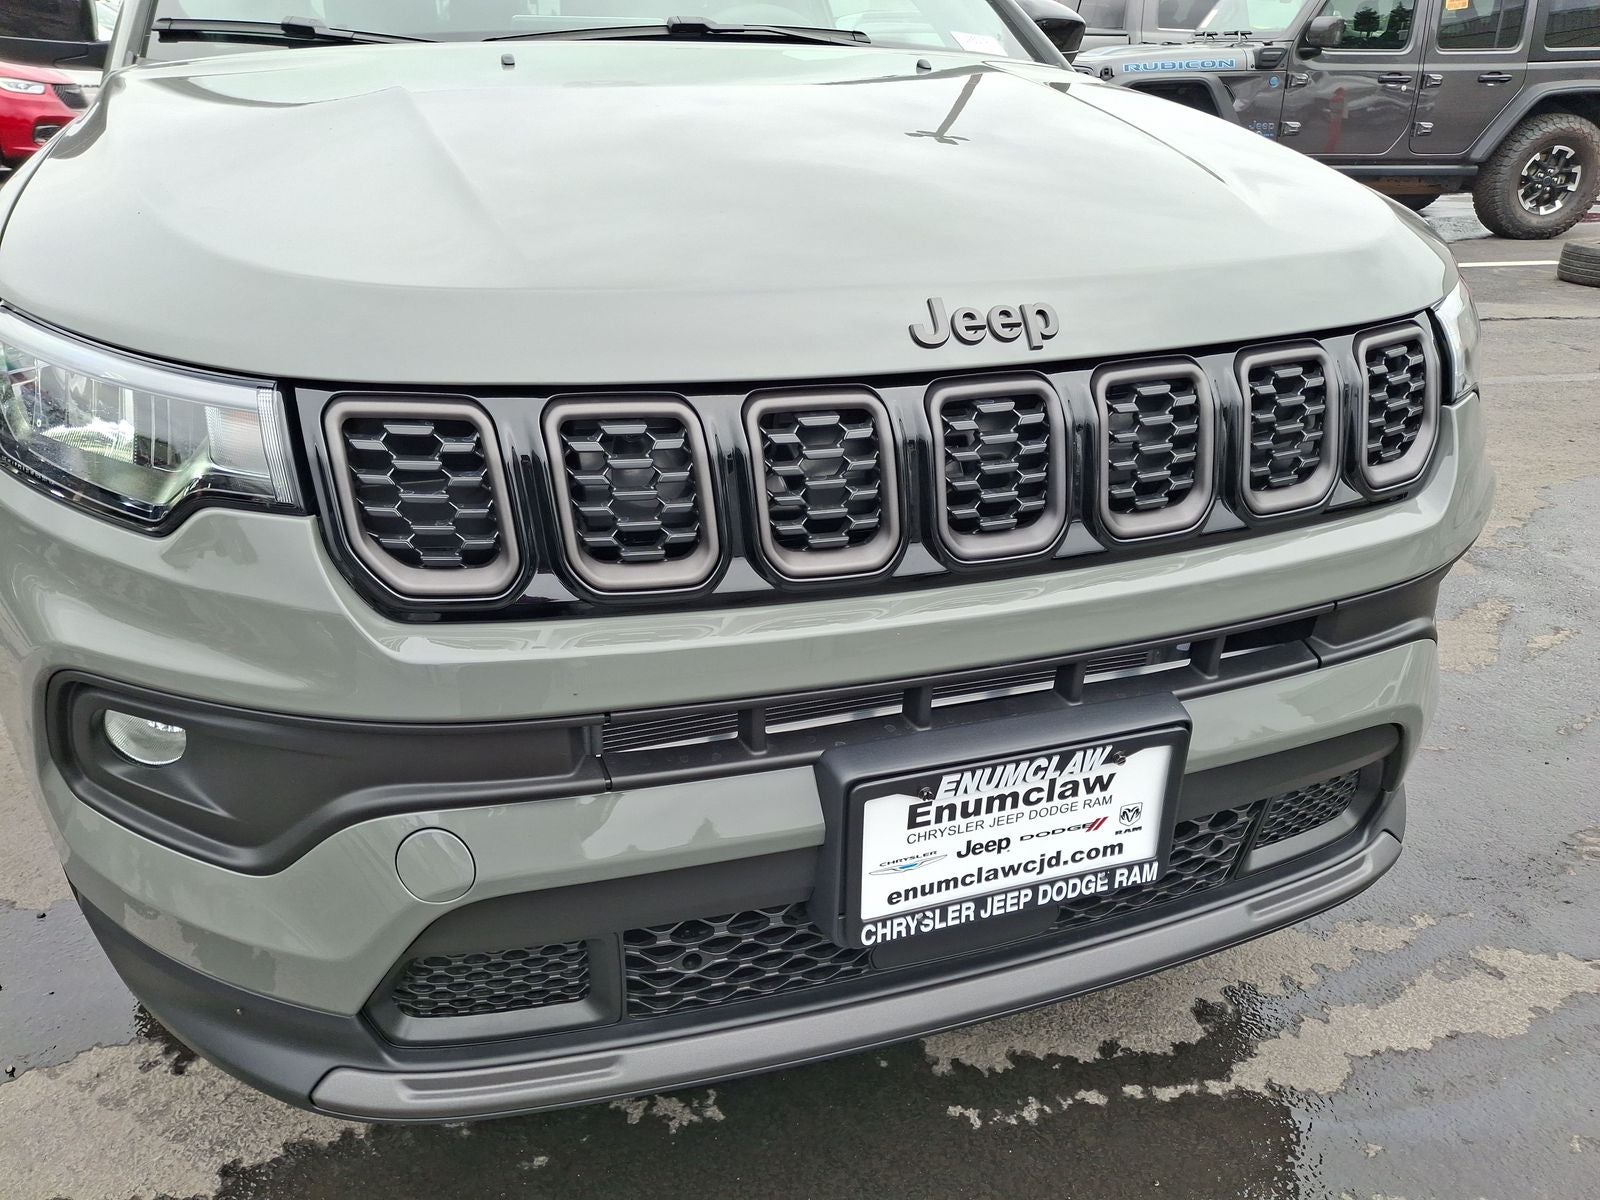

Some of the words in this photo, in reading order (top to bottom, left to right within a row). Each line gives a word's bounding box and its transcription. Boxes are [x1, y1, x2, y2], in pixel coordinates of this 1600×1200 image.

[1122, 59, 1237, 73] RUBICON
[908, 297, 1060, 351] Jeep
[935, 744, 1113, 801] ENUMCLAW
[906, 819, 985, 845] CHRYSLER
[989, 811, 1025, 828] JEEP
[1028, 800, 1079, 820] DODGE
[1083, 794, 1113, 810] RAM
[907, 772, 1117, 831] Enumclaw
[956, 835, 1011, 859] Jeep
[1019, 821, 1095, 842] DODGE
[1114, 825, 1143, 836] RAM
[879, 850, 937, 867] CHRYSLER
[887, 842, 1125, 906] enumclawcjd.com
[860, 901, 976, 946] CHRYSLER
[980, 887, 1033, 919] JEEP
[1037, 872, 1109, 906] DODGE
[1114, 860, 1159, 889] RAM
